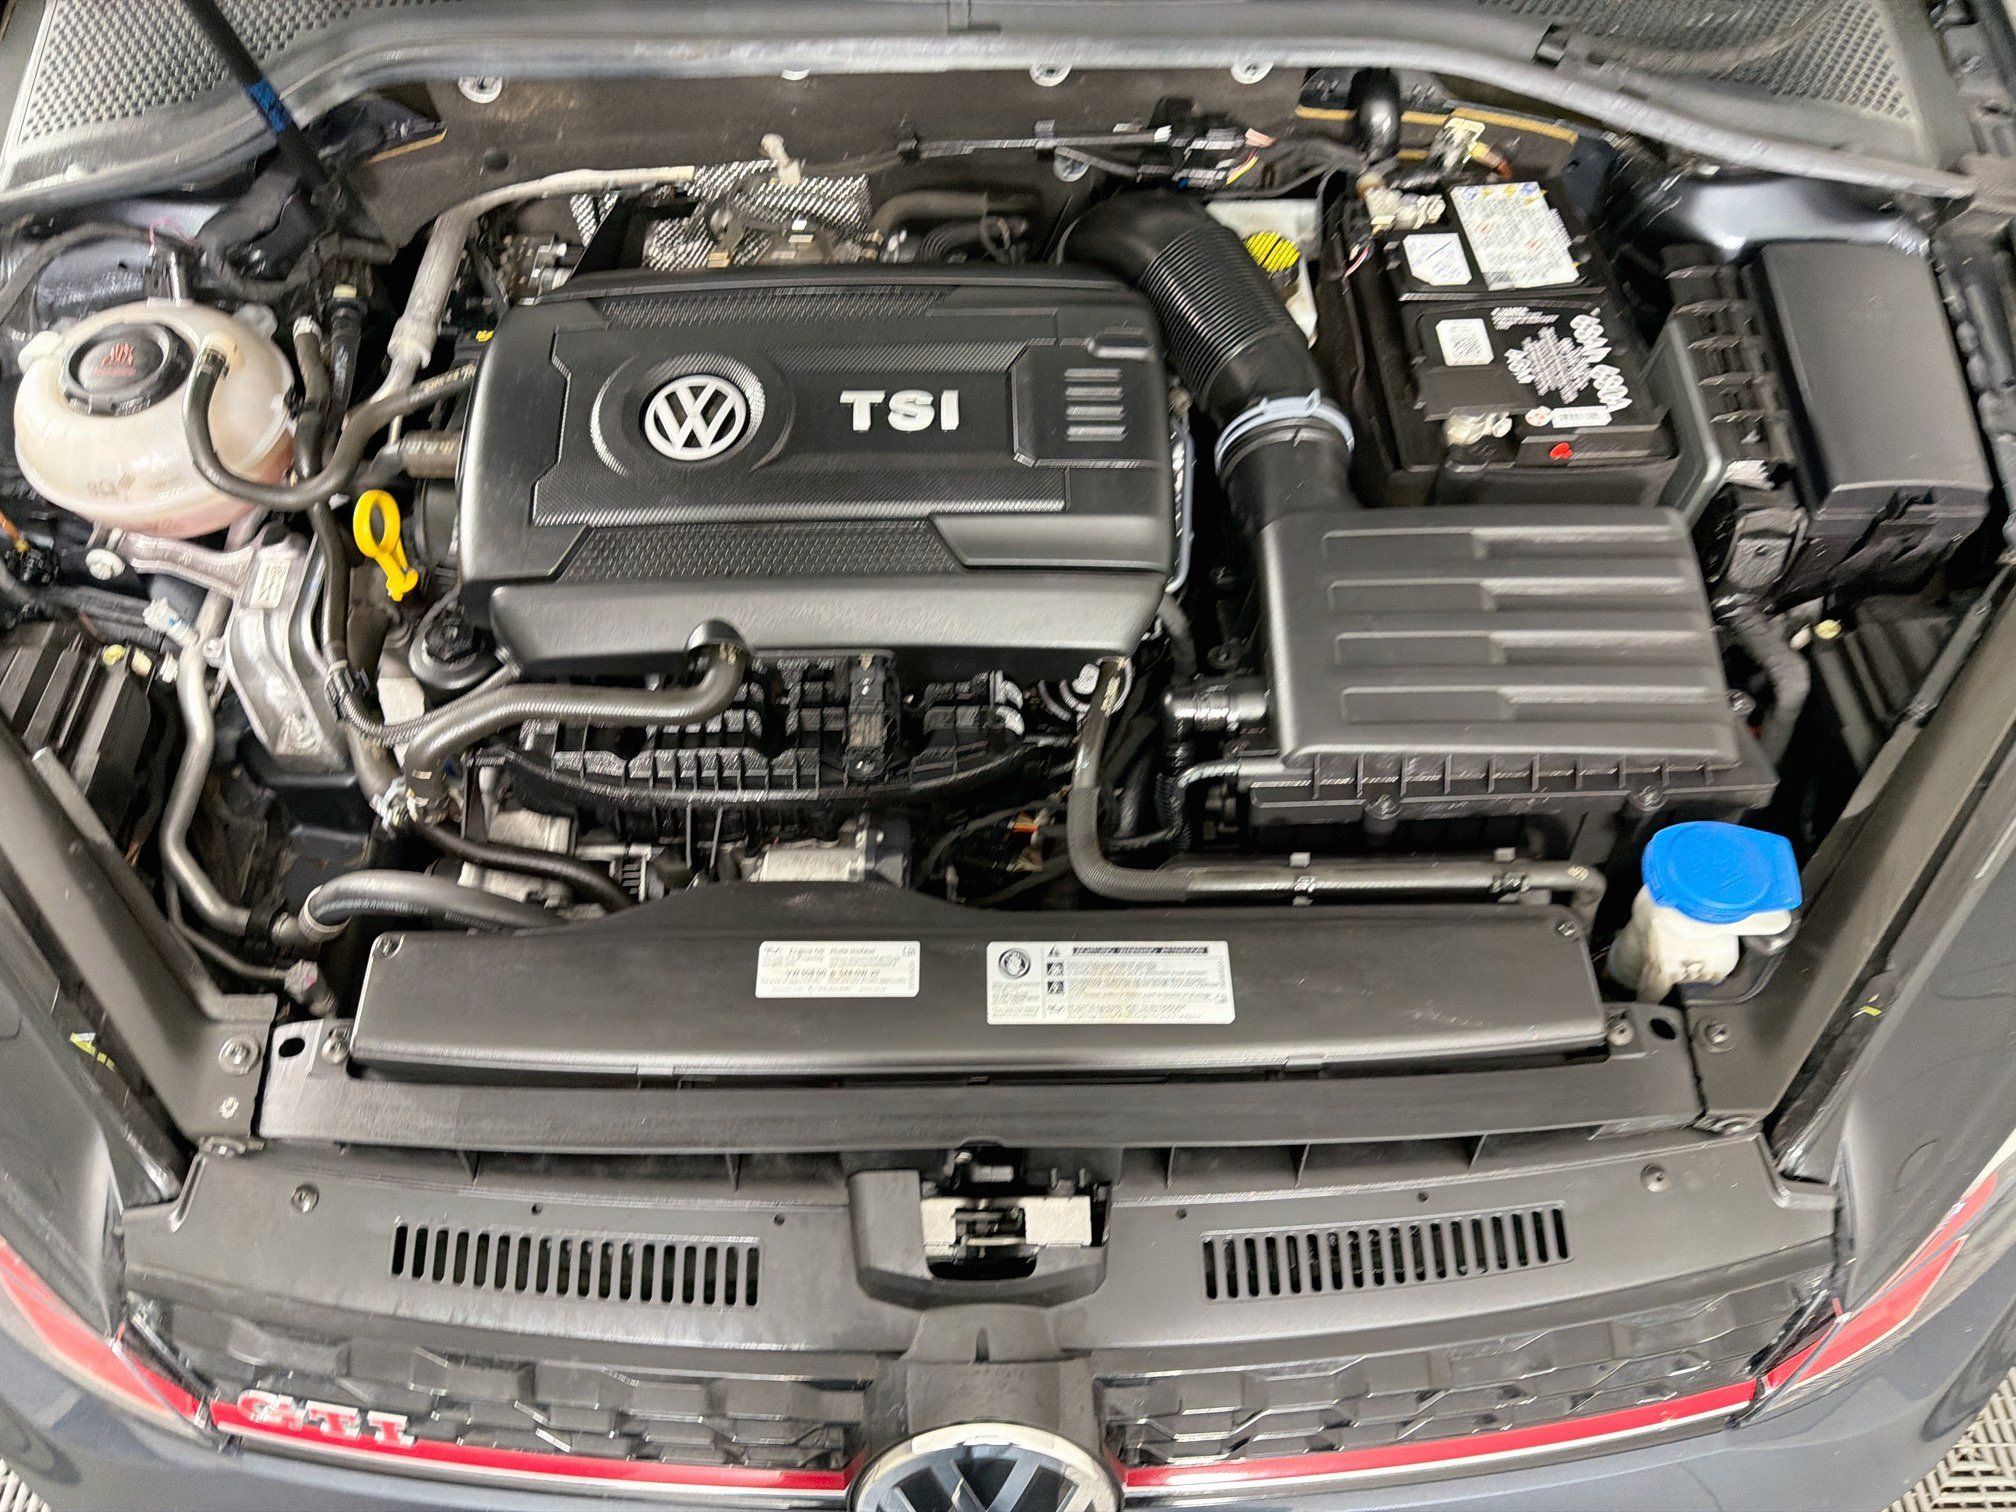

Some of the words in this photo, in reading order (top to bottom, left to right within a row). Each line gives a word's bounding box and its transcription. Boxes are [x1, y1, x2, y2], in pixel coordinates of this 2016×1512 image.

[644, 374, 747, 461] VW
[839, 389, 960, 432] TSI
[237, 1389, 416, 1449] GTI
